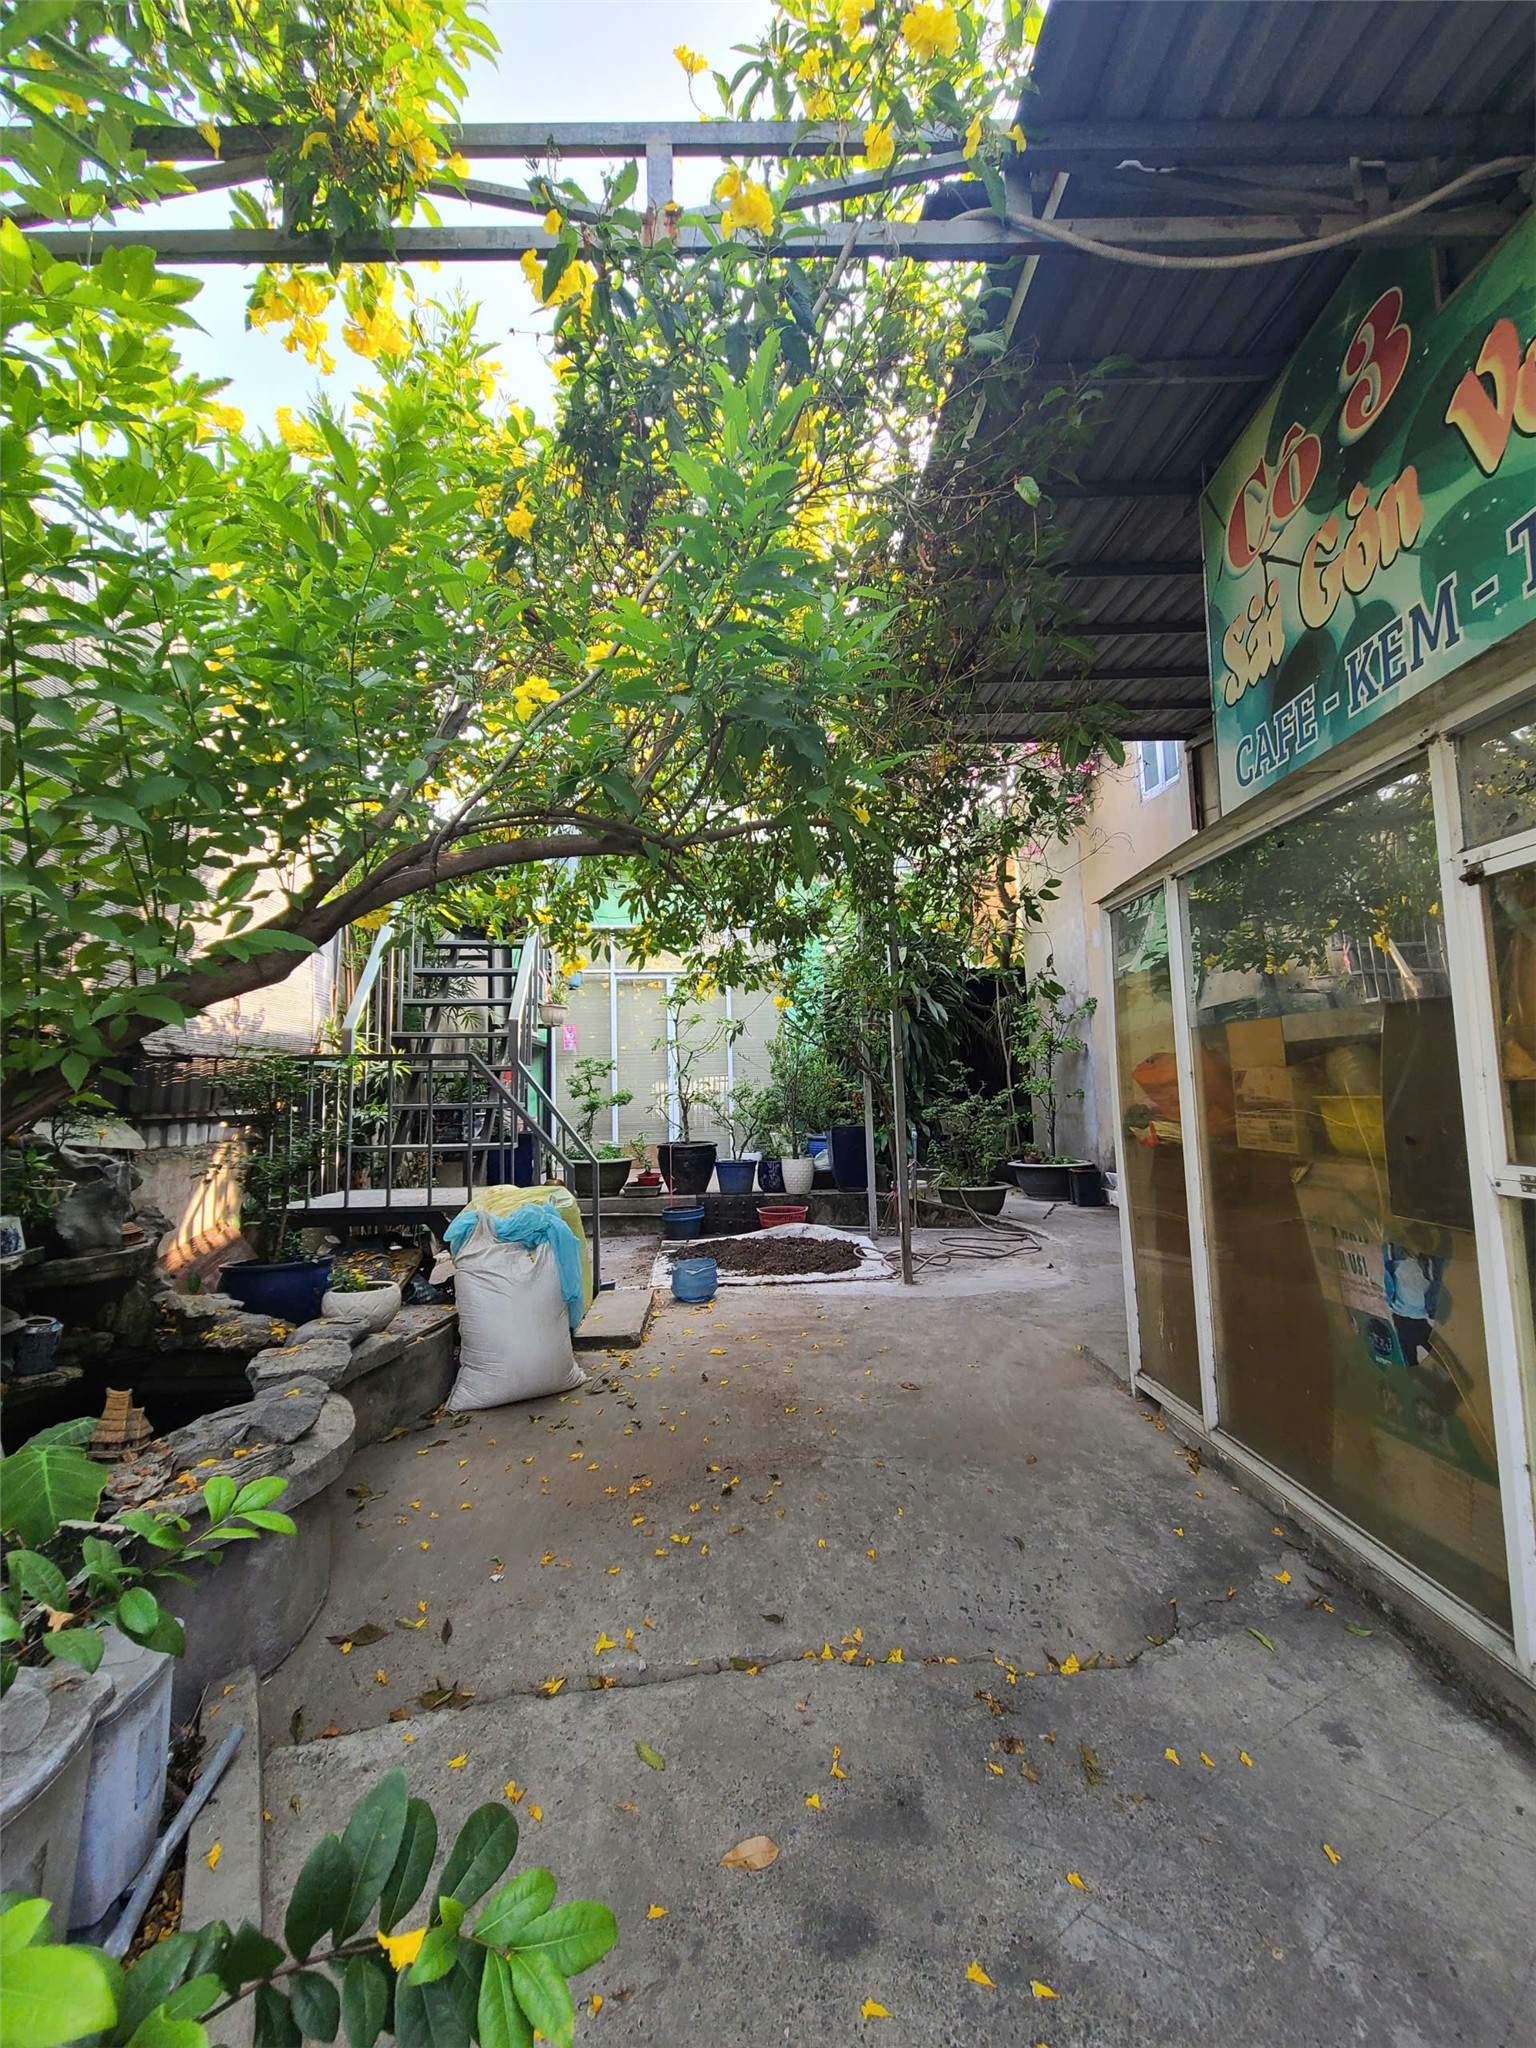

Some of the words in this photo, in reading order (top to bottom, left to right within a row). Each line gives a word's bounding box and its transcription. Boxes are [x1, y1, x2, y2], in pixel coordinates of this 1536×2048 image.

[1224, 422, 1321, 580] Cô
[1339, 287, 1411, 446] 3
[1222, 576, 1285, 708] Sài
[1298, 465, 1424, 631] Gòn
[1235, 683, 1319, 788] CAFE
[1344, 570, 1464, 719] KEM
